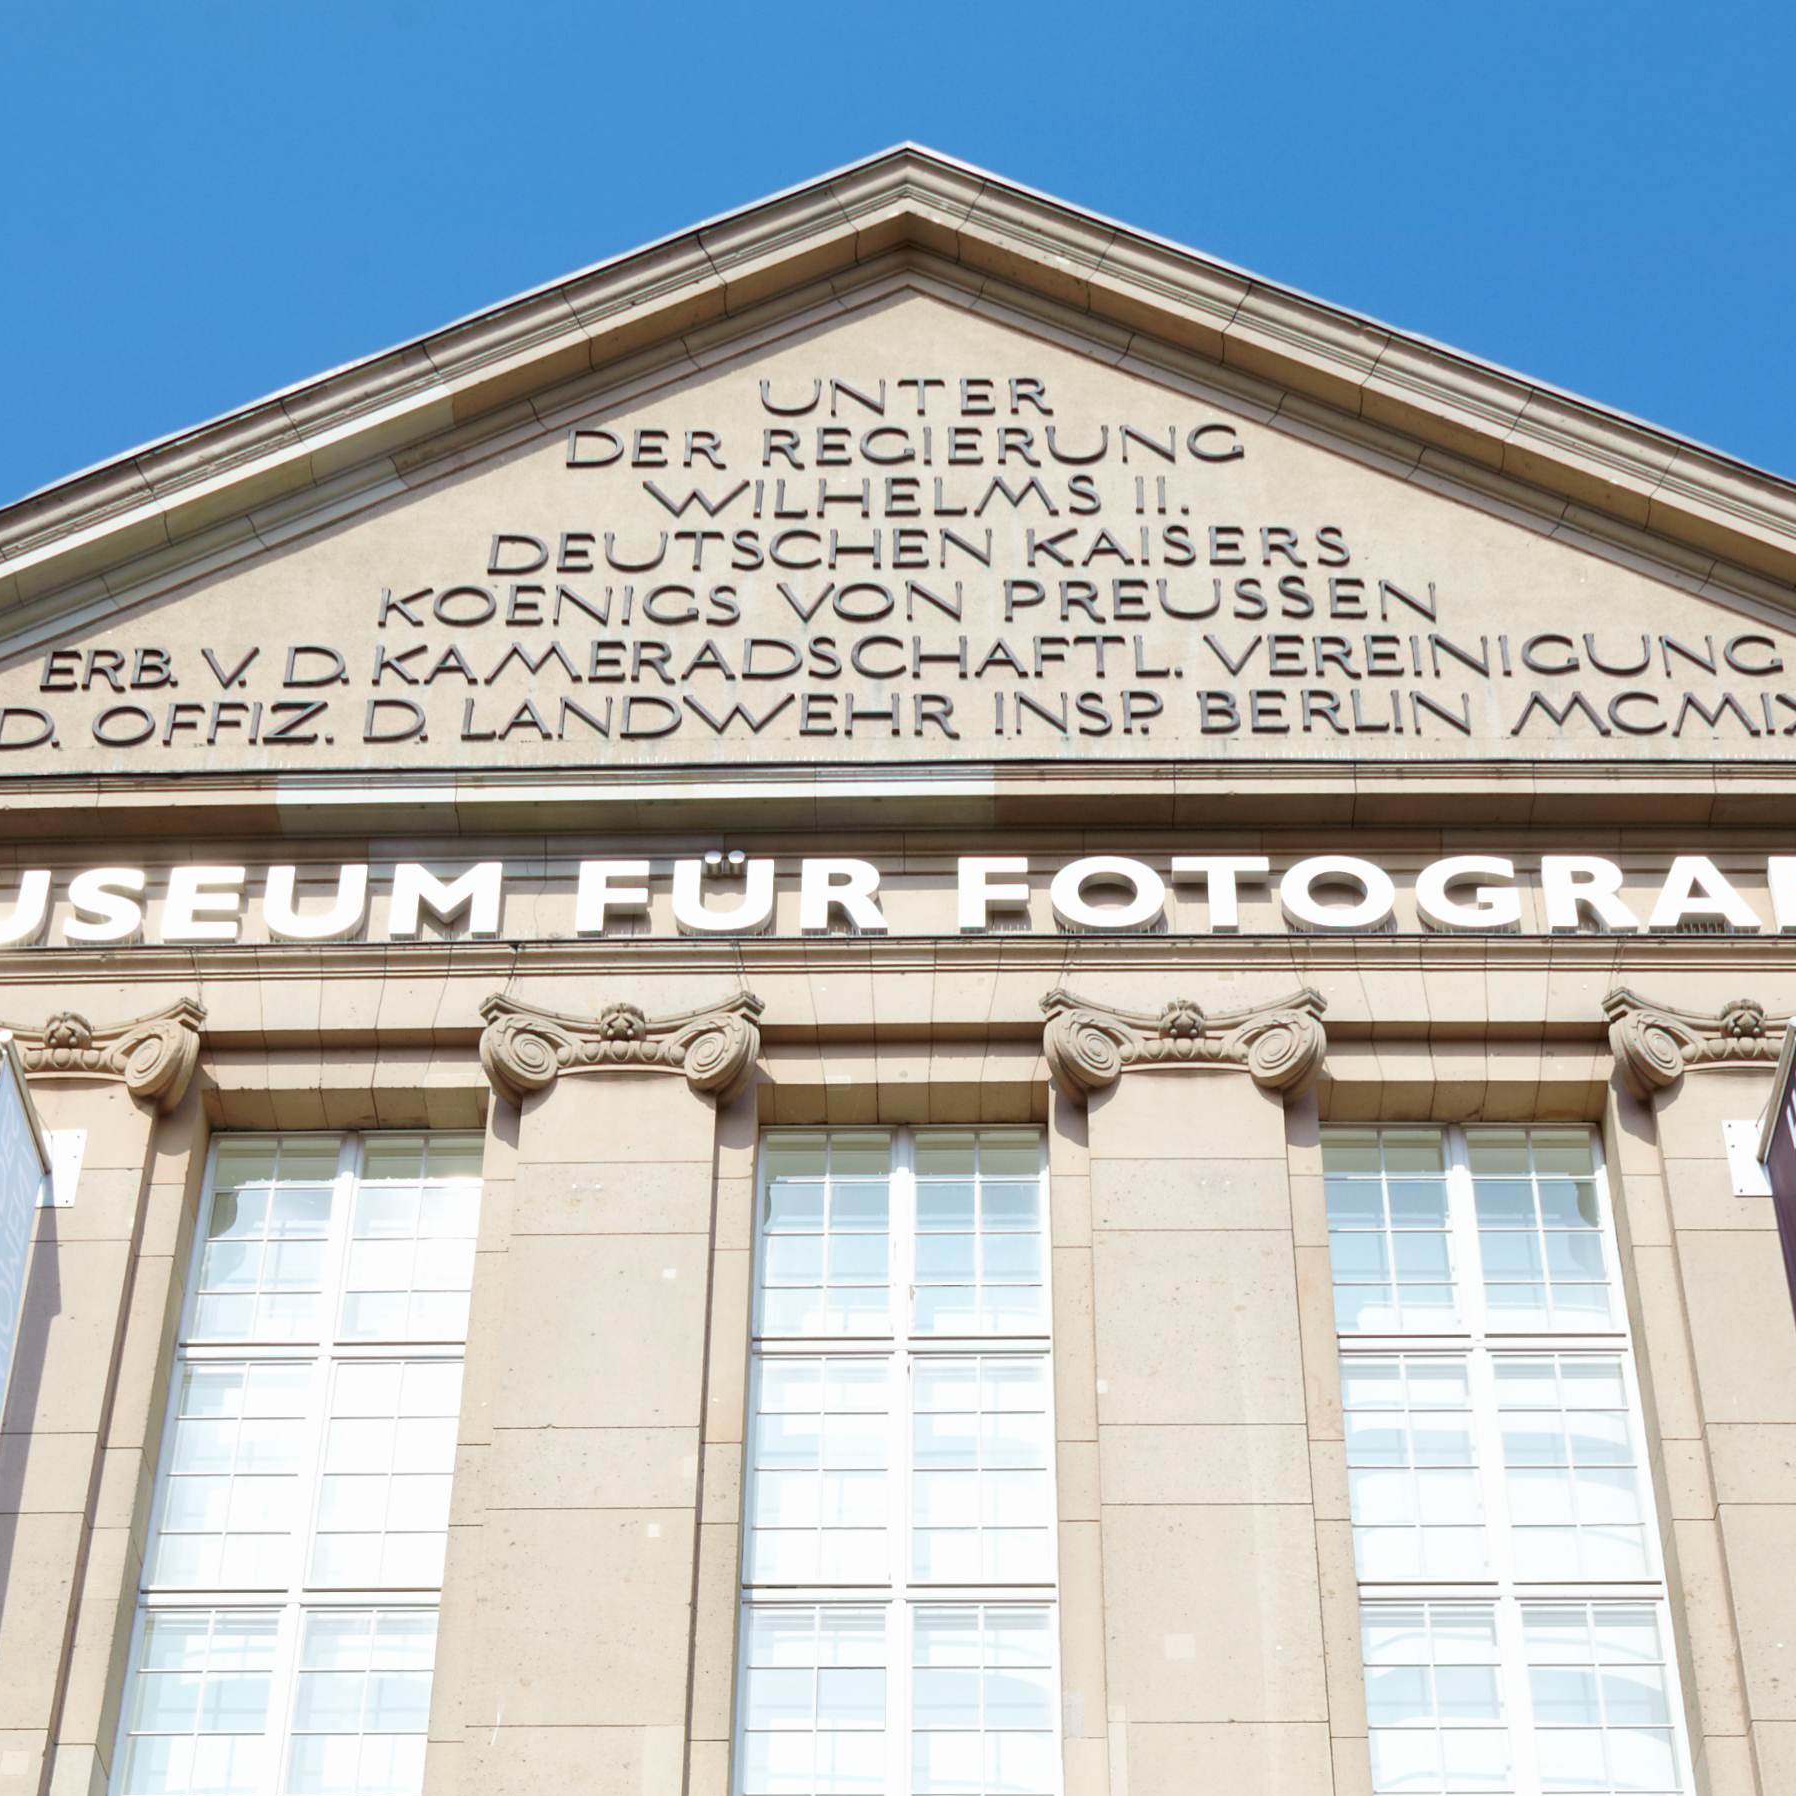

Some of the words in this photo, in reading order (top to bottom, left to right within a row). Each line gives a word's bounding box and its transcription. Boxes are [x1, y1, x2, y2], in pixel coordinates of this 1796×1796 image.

[762, 378, 1053, 417] UNTER
[566, 428, 726, 470] DER
[762, 424, 1244, 470] REGIERUNG
[643, 475, 1101, 520] WILHELMS
[1135, 476, 1189, 516] II.
[487, 529, 992, 576] DEUTSCHEN
[1028, 525, 1350, 568] KAISERS
[378, 585, 740, 628] KOENIGS
[777, 583, 961, 624] VON
[1004, 576, 1436, 624] PREUSSEN
[40, 647, 178, 693] ERB.
[201, 647, 260, 690] V.
[283, 646, 349, 688] D.
[372, 636, 1183, 686] KAMERADSCHAFTL.
[1203, 634, 1783, 680] VEREINIGUNG
[93, 702, 334, 748] OFFIZ.
[363, 700, 428, 744] D.
[461, 694, 960, 742] LANDWEHR
[995, 691, 1163, 737] INSP.
[1197, 690, 1471, 736] BERLIN
[576, 850, 888, 936] FÜR
